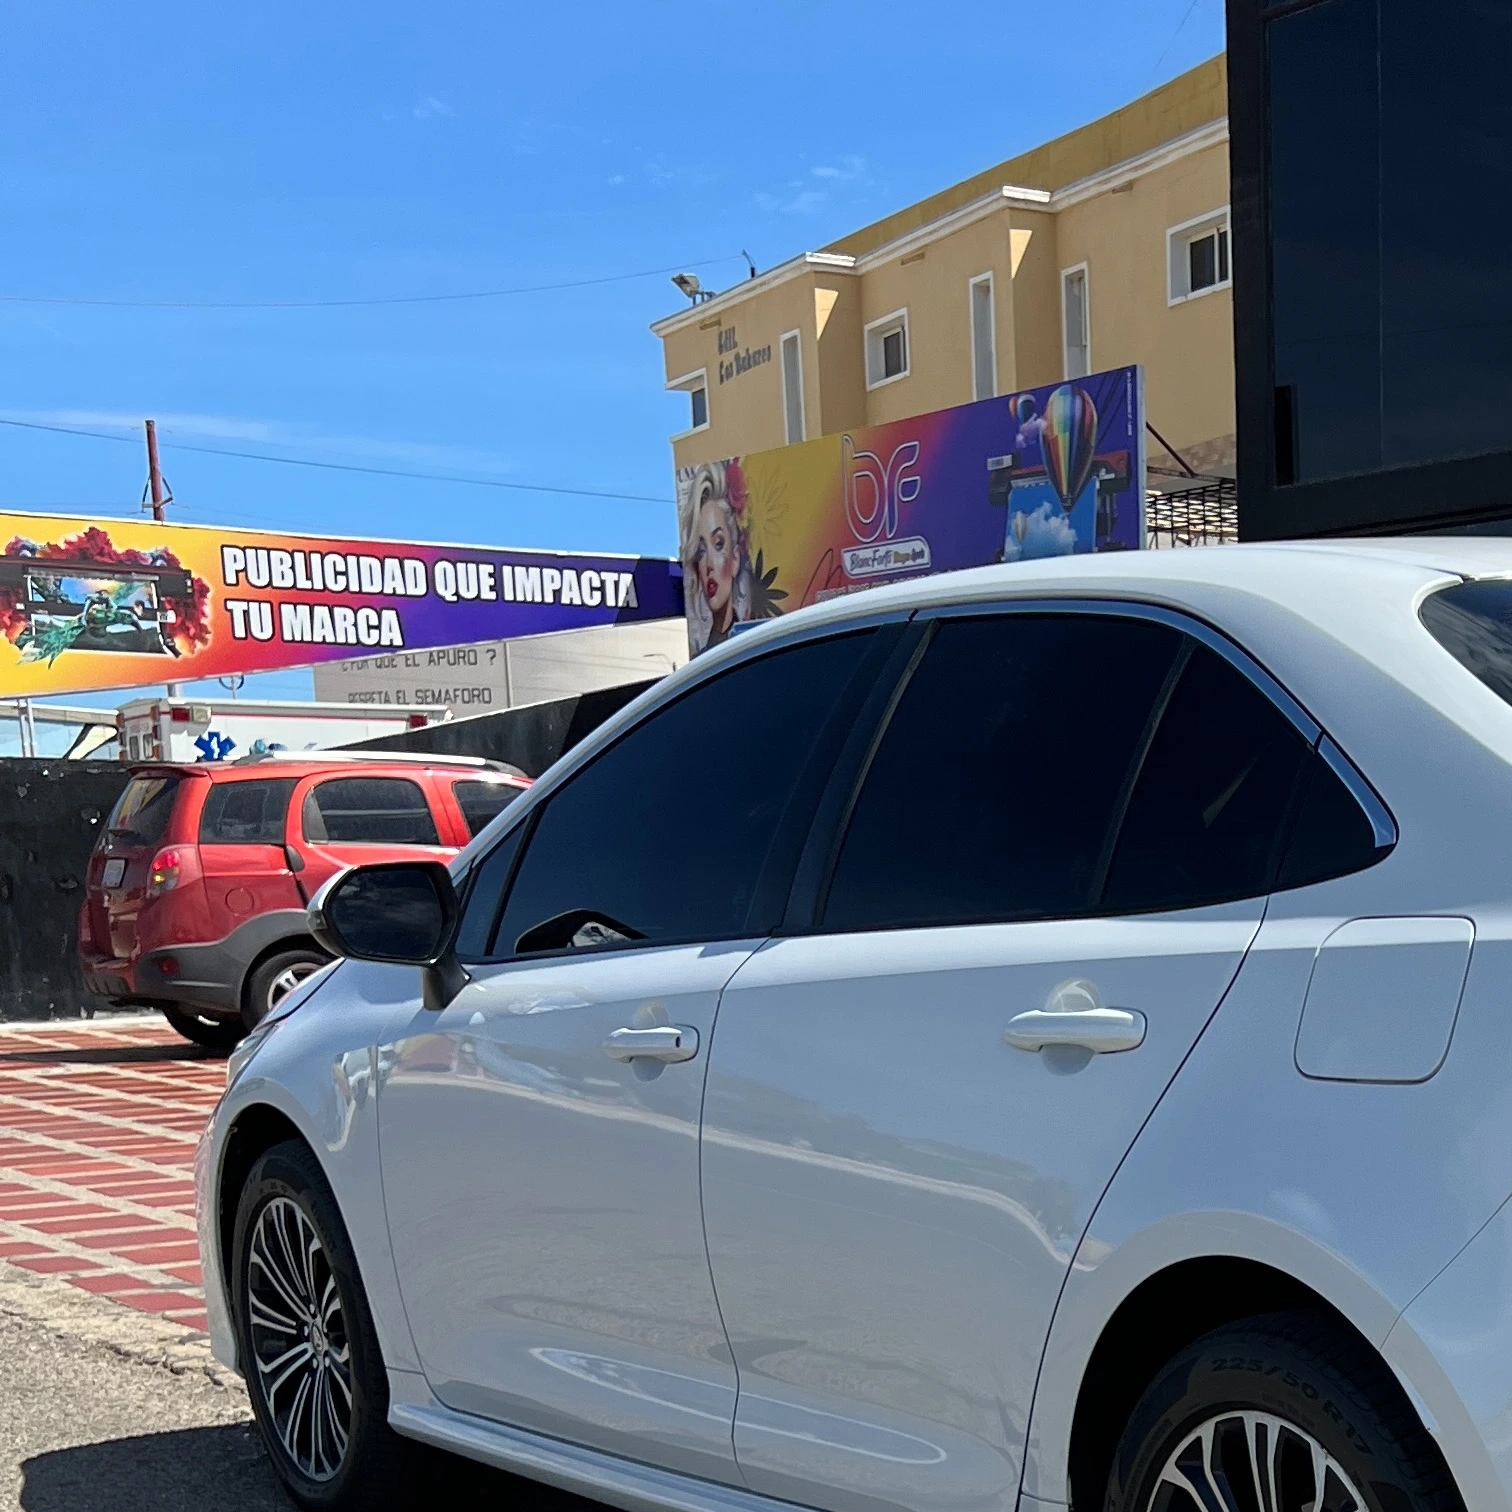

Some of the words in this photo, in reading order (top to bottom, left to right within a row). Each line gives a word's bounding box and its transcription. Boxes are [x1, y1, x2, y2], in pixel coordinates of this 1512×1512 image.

[222, 545, 428, 597] PUBLICIDAD
[434, 560, 497, 602] QUE
[502, 565, 639, 608] IMPACTA
[225, 599, 274, 641] TU
[279, 602, 404, 647] MARCA
[405, 655, 420, 667] EL
[428, 649, 478, 666] APURO
[396, 690, 410, 705] EL
[415, 687, 492, 705] SEMAFORO
[1212, 1357, 1319, 1401] 225/50
[1323, 1399, 1375, 1457] R17
